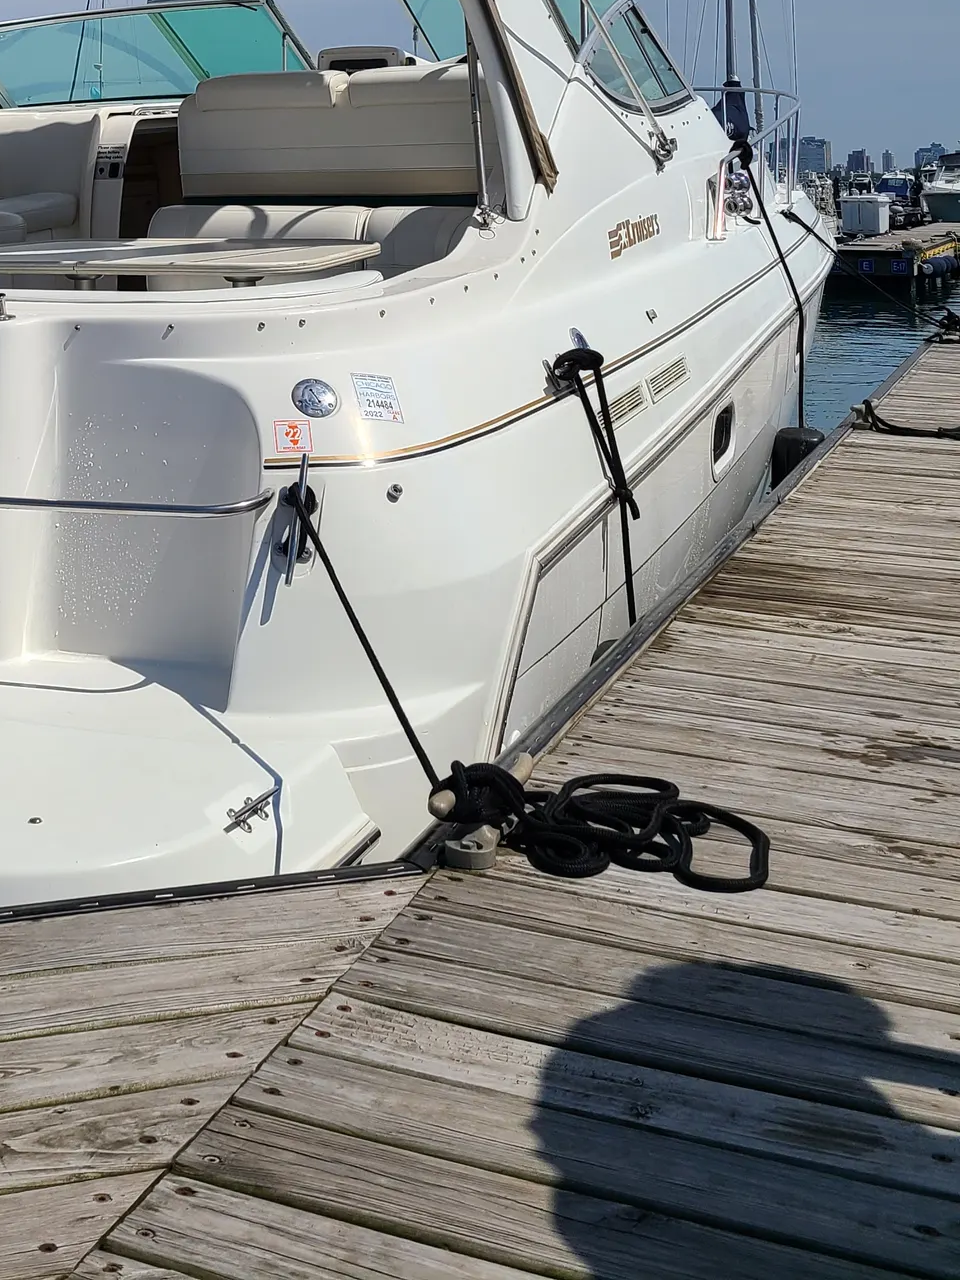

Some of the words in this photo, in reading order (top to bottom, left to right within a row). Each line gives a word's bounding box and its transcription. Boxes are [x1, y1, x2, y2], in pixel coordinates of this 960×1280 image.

[862, 261, 870, 271] E
[355, 380, 393, 391] CHICAGO
[359, 391, 396, 401] HARBORS
[363, 410, 384, 418] 2022
